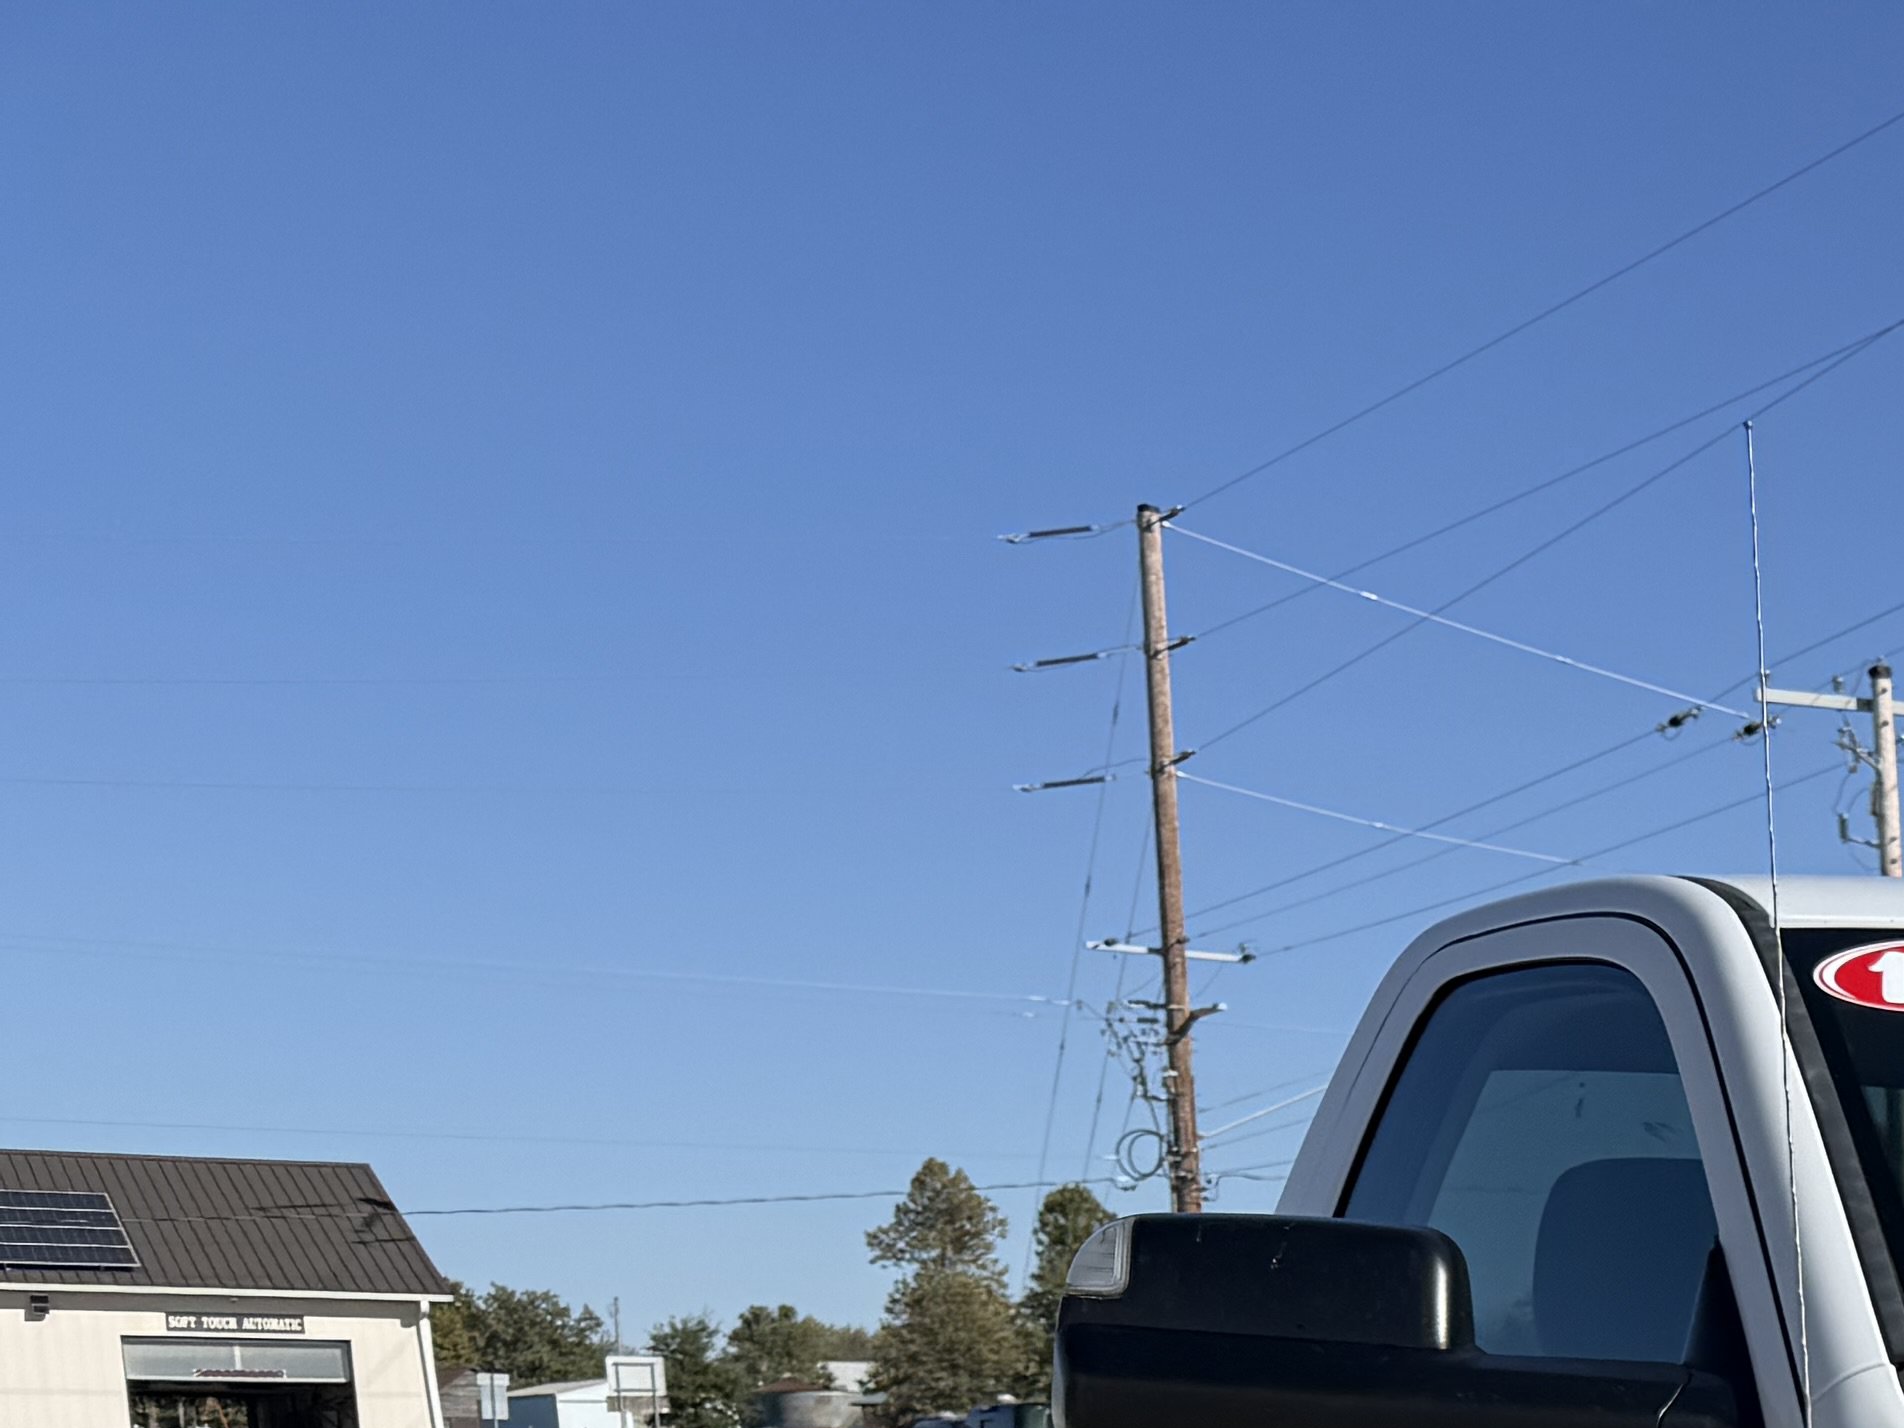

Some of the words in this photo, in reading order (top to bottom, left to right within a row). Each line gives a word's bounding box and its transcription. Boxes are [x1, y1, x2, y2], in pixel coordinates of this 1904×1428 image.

[168, 1315, 197, 1329] SOFT
[201, 1316, 238, 1330] TOUCH
[242, 1317, 303, 1331] AUTOMATIC
